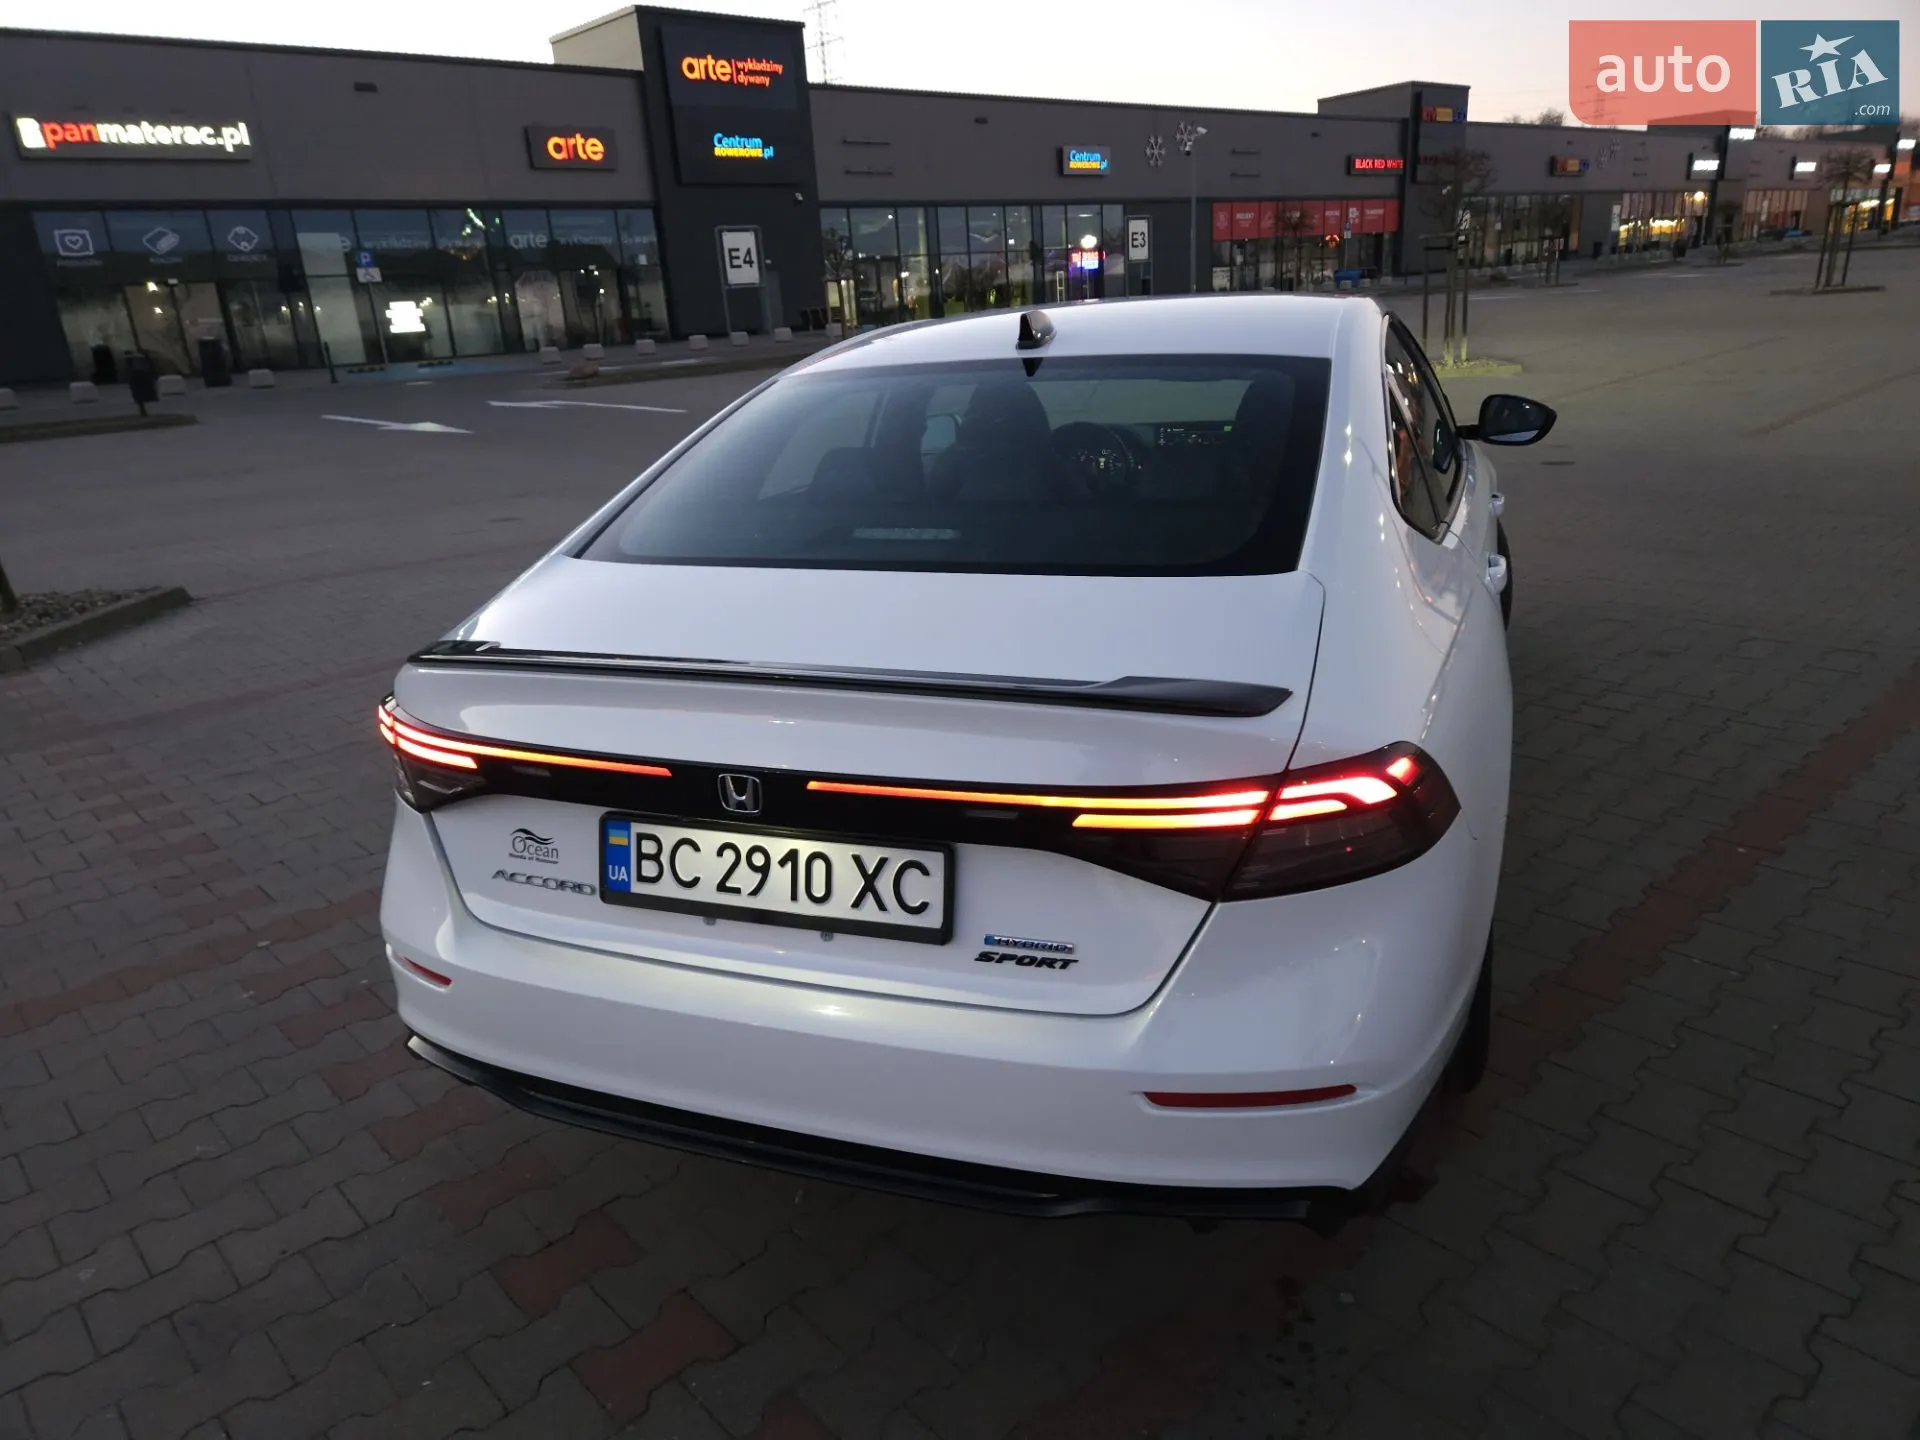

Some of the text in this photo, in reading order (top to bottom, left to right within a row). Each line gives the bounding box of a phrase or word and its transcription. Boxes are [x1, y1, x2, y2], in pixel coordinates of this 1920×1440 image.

[681, 54, 732, 81] arte
[737, 71, 771, 87] dywany
[42, 121, 251, 152] panmaterac.pl
[713, 133, 762, 148] Centrum
[547, 133, 605, 161] arte
[1070, 150, 1101, 162] Centrum
[1355, 159, 1373, 169] BLACK
[1374, 159, 1386, 169] RED
[1131, 231, 1146, 248] E3
[360, 253, 370, 266] P
[728, 248, 754, 269] E4
[512, 836, 559, 859] Ocean
[491, 868, 596, 896] ACCORD
[608, 832, 931, 915] UA BC 2910 XC
[974, 951, 1079, 970] SPORT
